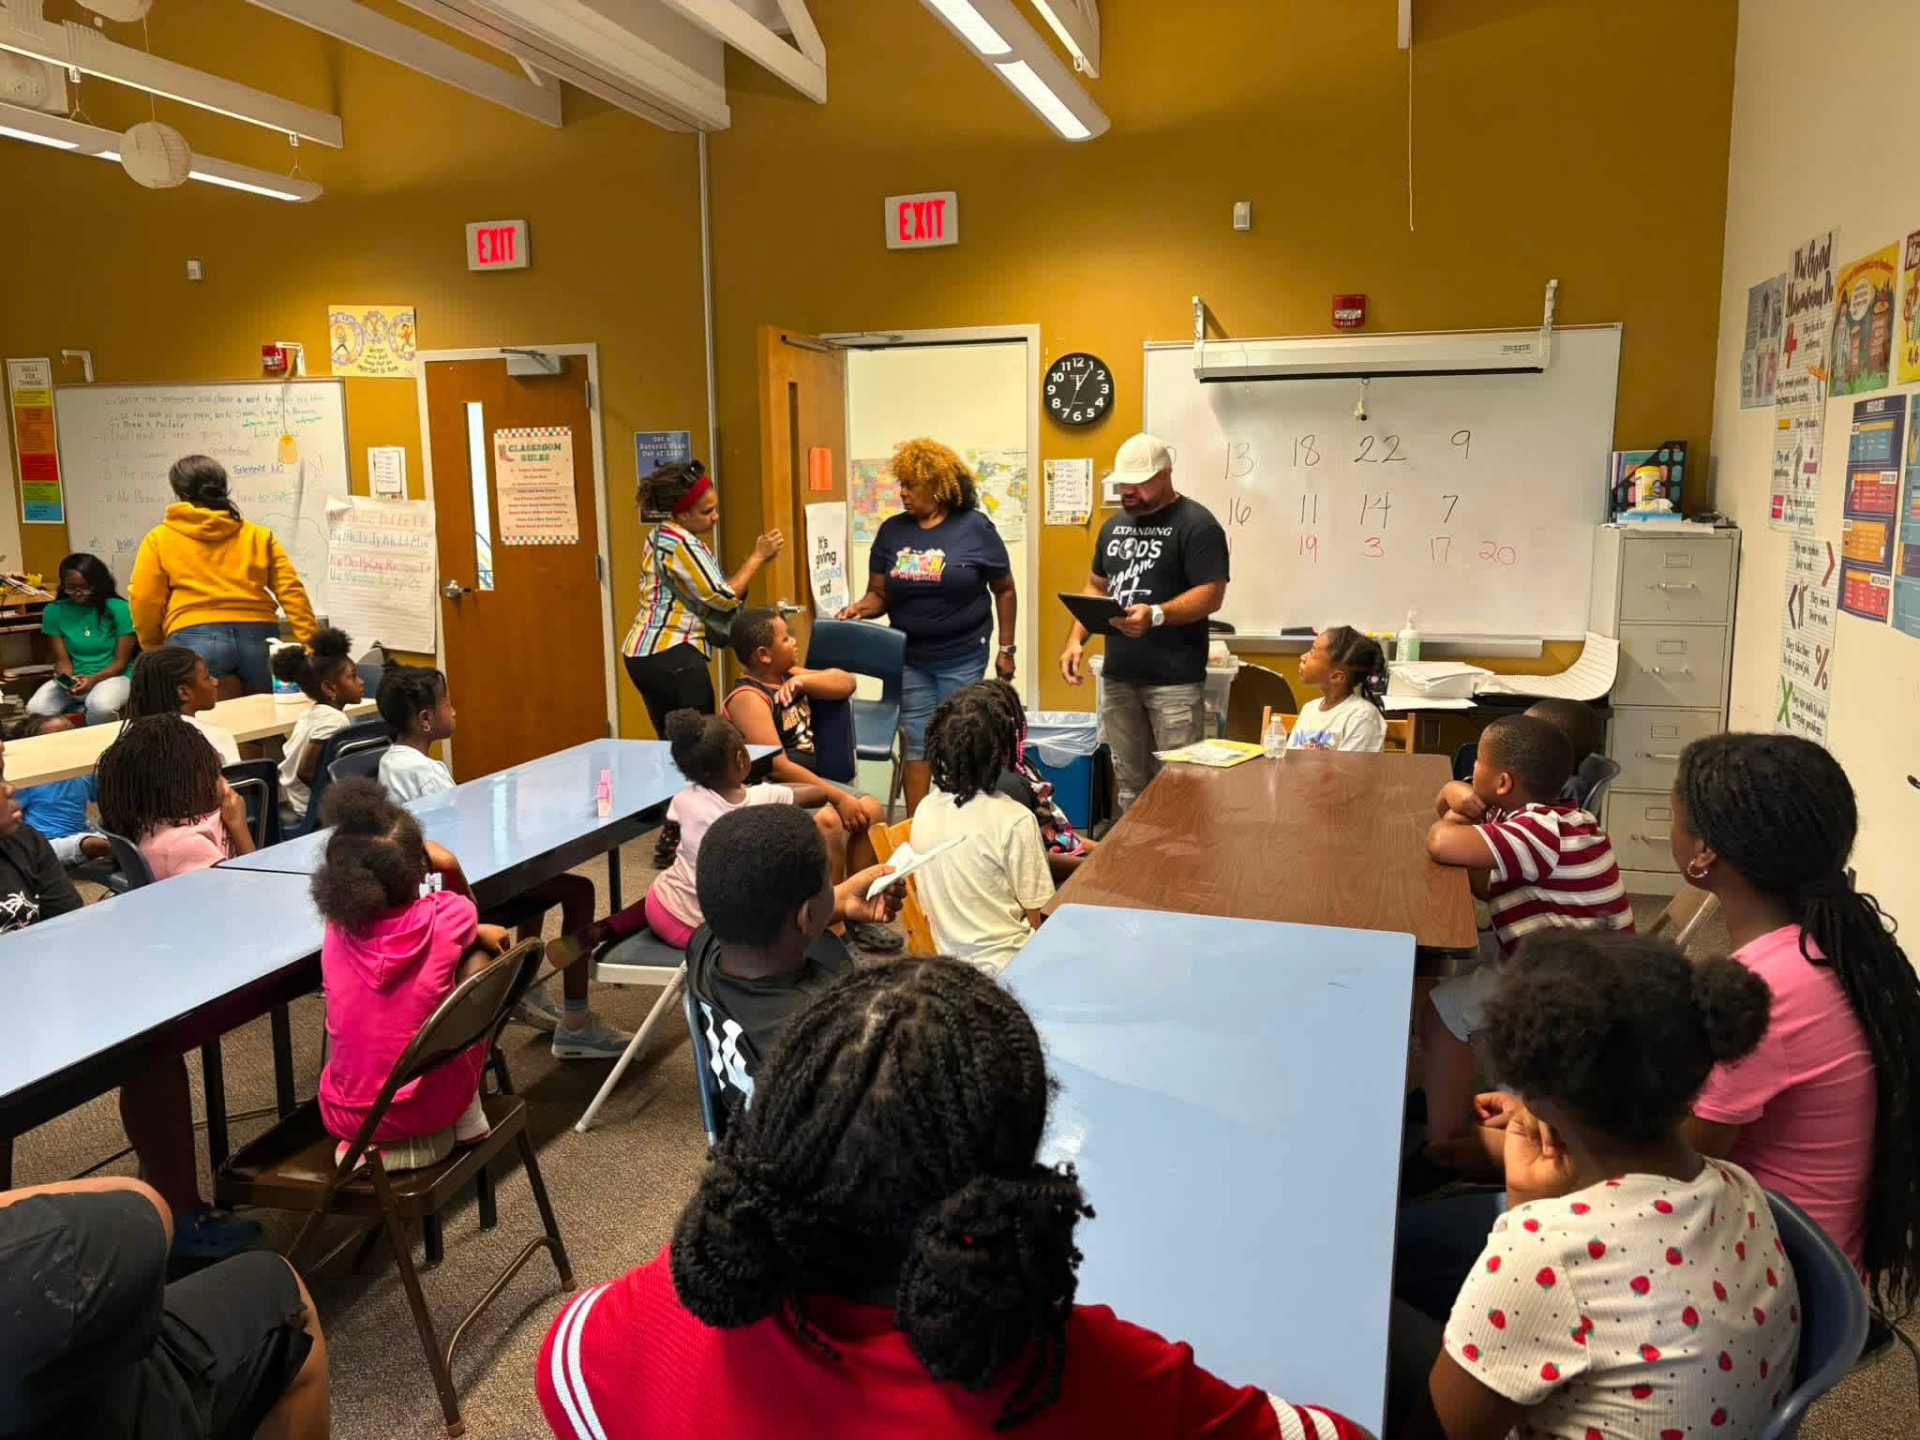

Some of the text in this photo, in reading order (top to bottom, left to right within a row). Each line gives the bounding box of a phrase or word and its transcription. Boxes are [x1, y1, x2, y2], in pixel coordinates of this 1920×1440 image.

[897, 199, 945, 241] EXIT
[477, 226, 516, 264] EXIT
[1807, 232, 1832, 281] Good
[1061, 361, 1071, 371] 11
[1072, 357, 1085, 367] 12
[1088, 360, 1094, 371] 1
[1051, 372, 1065, 382] 10
[1096, 369, 1106, 380] 2
[1046, 384, 1057, 395] 9
[1100, 383, 1110, 394] 3
[1051, 397, 1062, 409] 8
[1094, 396, 1105, 407] 4
[1062, 407, 1070, 419] 7
[1072, 411, 1082, 421] 6
[1086, 408, 1095, 418] 5
[508, 443, 562, 452] CLASSROOM
[521, 453, 550, 462] RULES
[1224, 429, 1471, 480] 13 18 22 9
[1228, 491, 1459, 529] 16 11 14 7
[1112, 525, 1173, 536] EXPANDING
[1106, 537, 1163, 559] GOD'S
[1300, 534, 1317, 563] 19
[1363, 537, 1385, 558] 3
[1430, 536, 1451, 563] 17
[1479, 540, 1517, 566] 20
